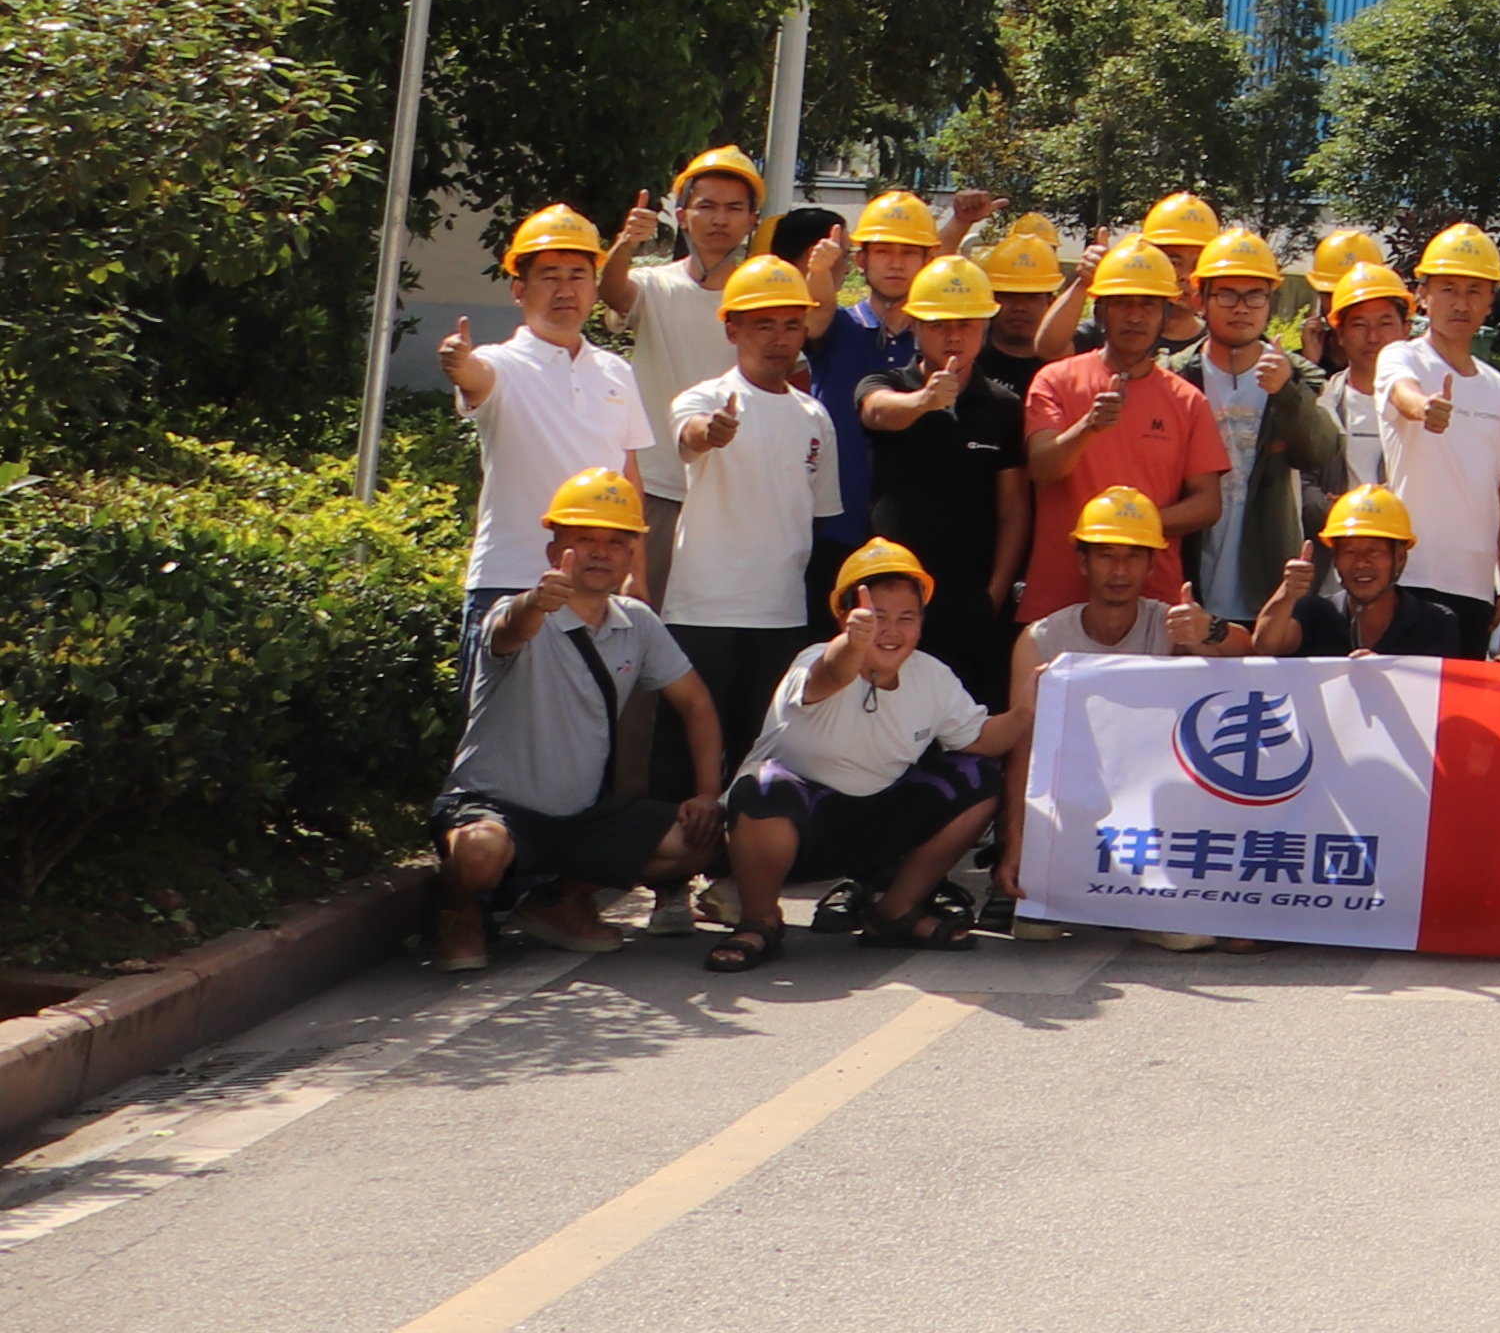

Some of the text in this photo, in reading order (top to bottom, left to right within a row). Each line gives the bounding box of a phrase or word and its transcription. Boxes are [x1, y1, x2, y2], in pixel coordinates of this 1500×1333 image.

[1095, 826, 1379, 886] 祥丰集团
[1087, 883, 1262, 904] XIANGFENG
